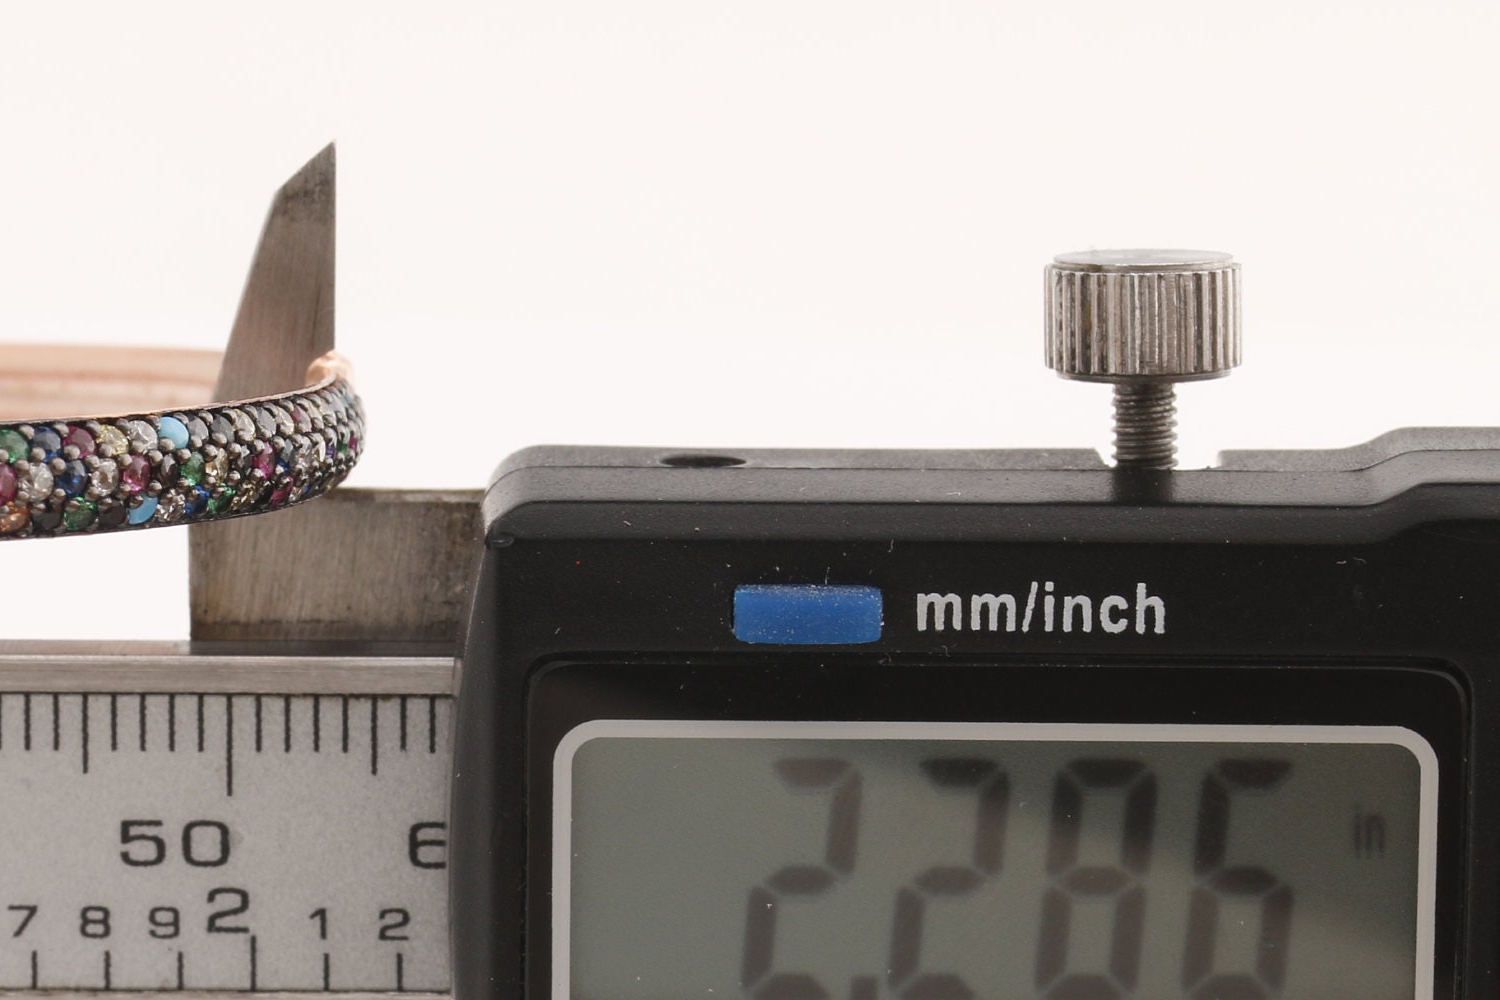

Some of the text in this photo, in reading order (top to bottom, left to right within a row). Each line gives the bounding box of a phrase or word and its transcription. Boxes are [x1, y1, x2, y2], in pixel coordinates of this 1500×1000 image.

[916, 581, 1165, 634] mm/inch
[119, 819, 232, 869] 50
[7, 904, 38, 938] 7
[79, 905, 112, 940] 8
[147, 906, 181, 940] 9
[205, 886, 251, 935] 2
[308, 907, 328, 941] 1
[377, 906, 413, 943] 2
